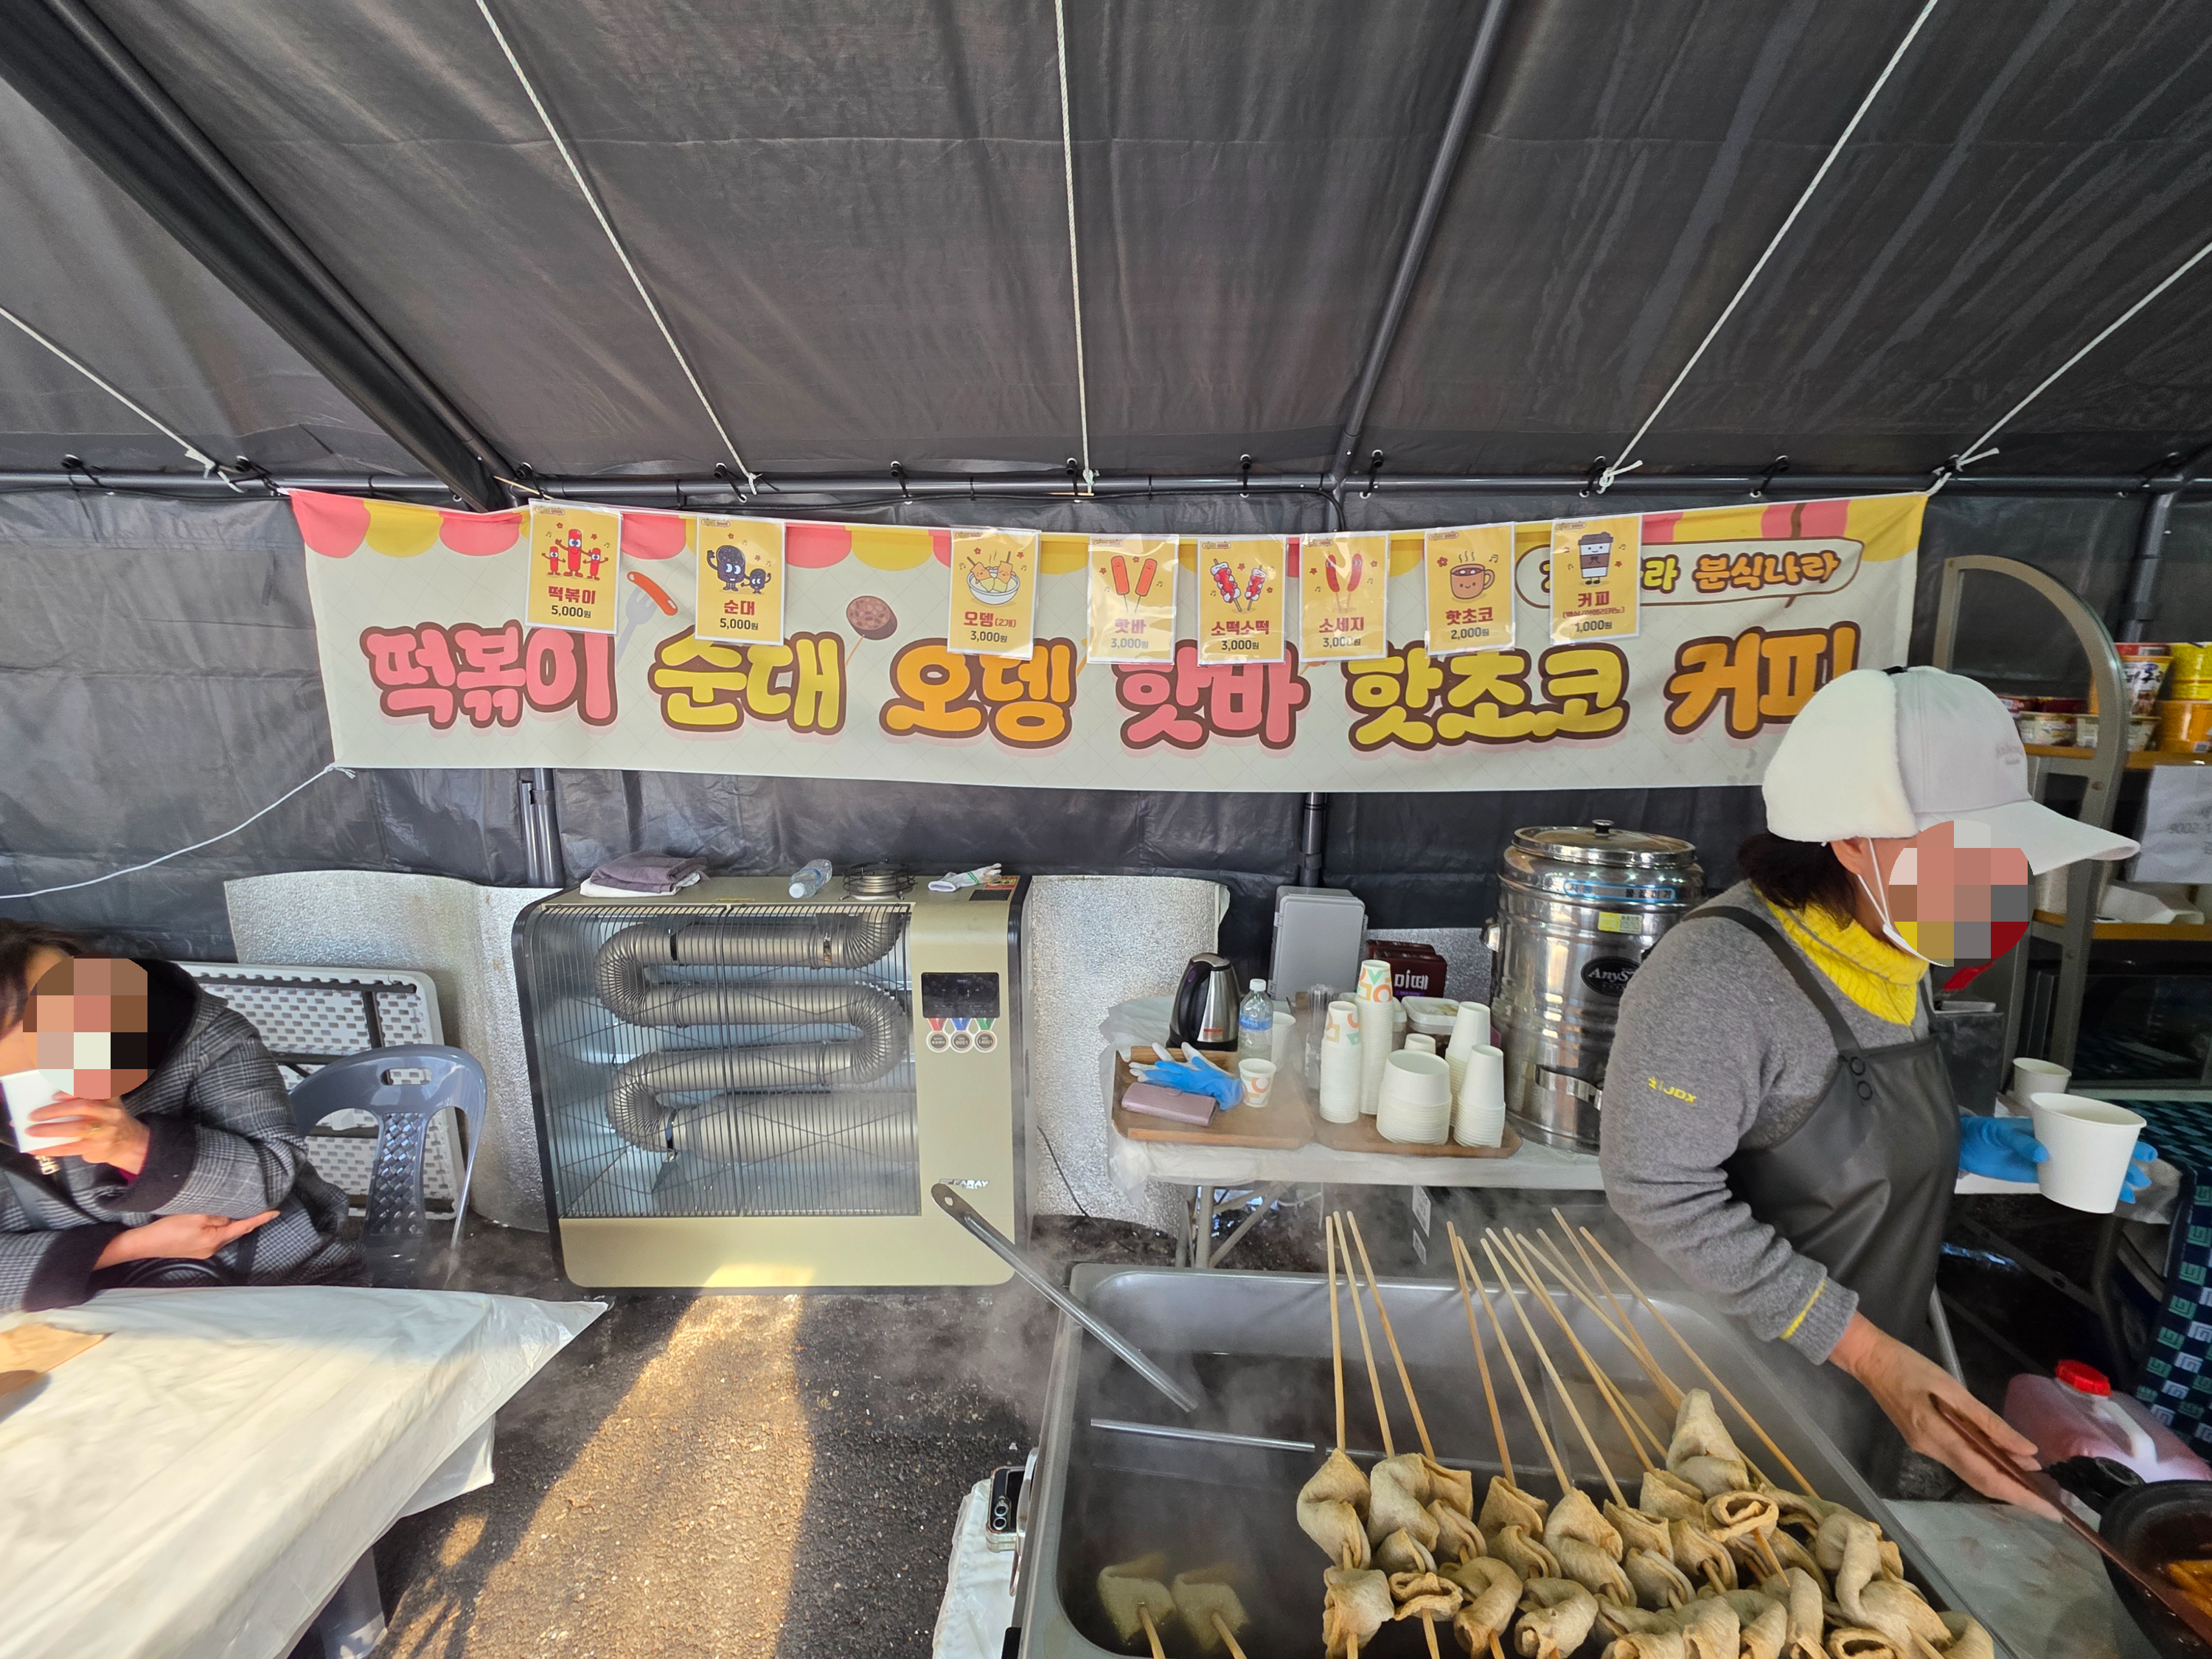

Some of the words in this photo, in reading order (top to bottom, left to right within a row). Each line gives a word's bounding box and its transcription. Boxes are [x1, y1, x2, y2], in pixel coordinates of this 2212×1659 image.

[1692, 550, 1841, 594] 분식나라
[548, 585, 597, 605] 떡볶이
[1578, 591, 1610, 608] 커피
[552, 605, 591, 619] 5,000원
[723, 599, 755, 616] 순대
[720, 618, 759, 630] 5,000원
[1318, 616, 1364, 633] 소세지
[1445, 607, 1493, 626] 핫초코
[1114, 618, 1147, 634] 핫바
[1211, 620, 1270, 636] 소떡소떡
[1450, 627, 1489, 640] 2,000원
[1575, 620, 1612, 632] 1,000원
[970, 630, 1008, 643] 3,000원
[1110, 637, 1149, 650] 3,000원
[1221, 640, 1259, 652] 3,000원
[361, 620, 618, 729] 떡볶이
[648, 630, 845, 734] 순대
[879, 638, 1077, 748] 오뎅
[1112, 639, 1311, 750] 핫바
[1341, 640, 1629, 751] 핫초코
[1663, 621, 1859, 740] 커피
[1588, 967, 1635, 982] AnyS
